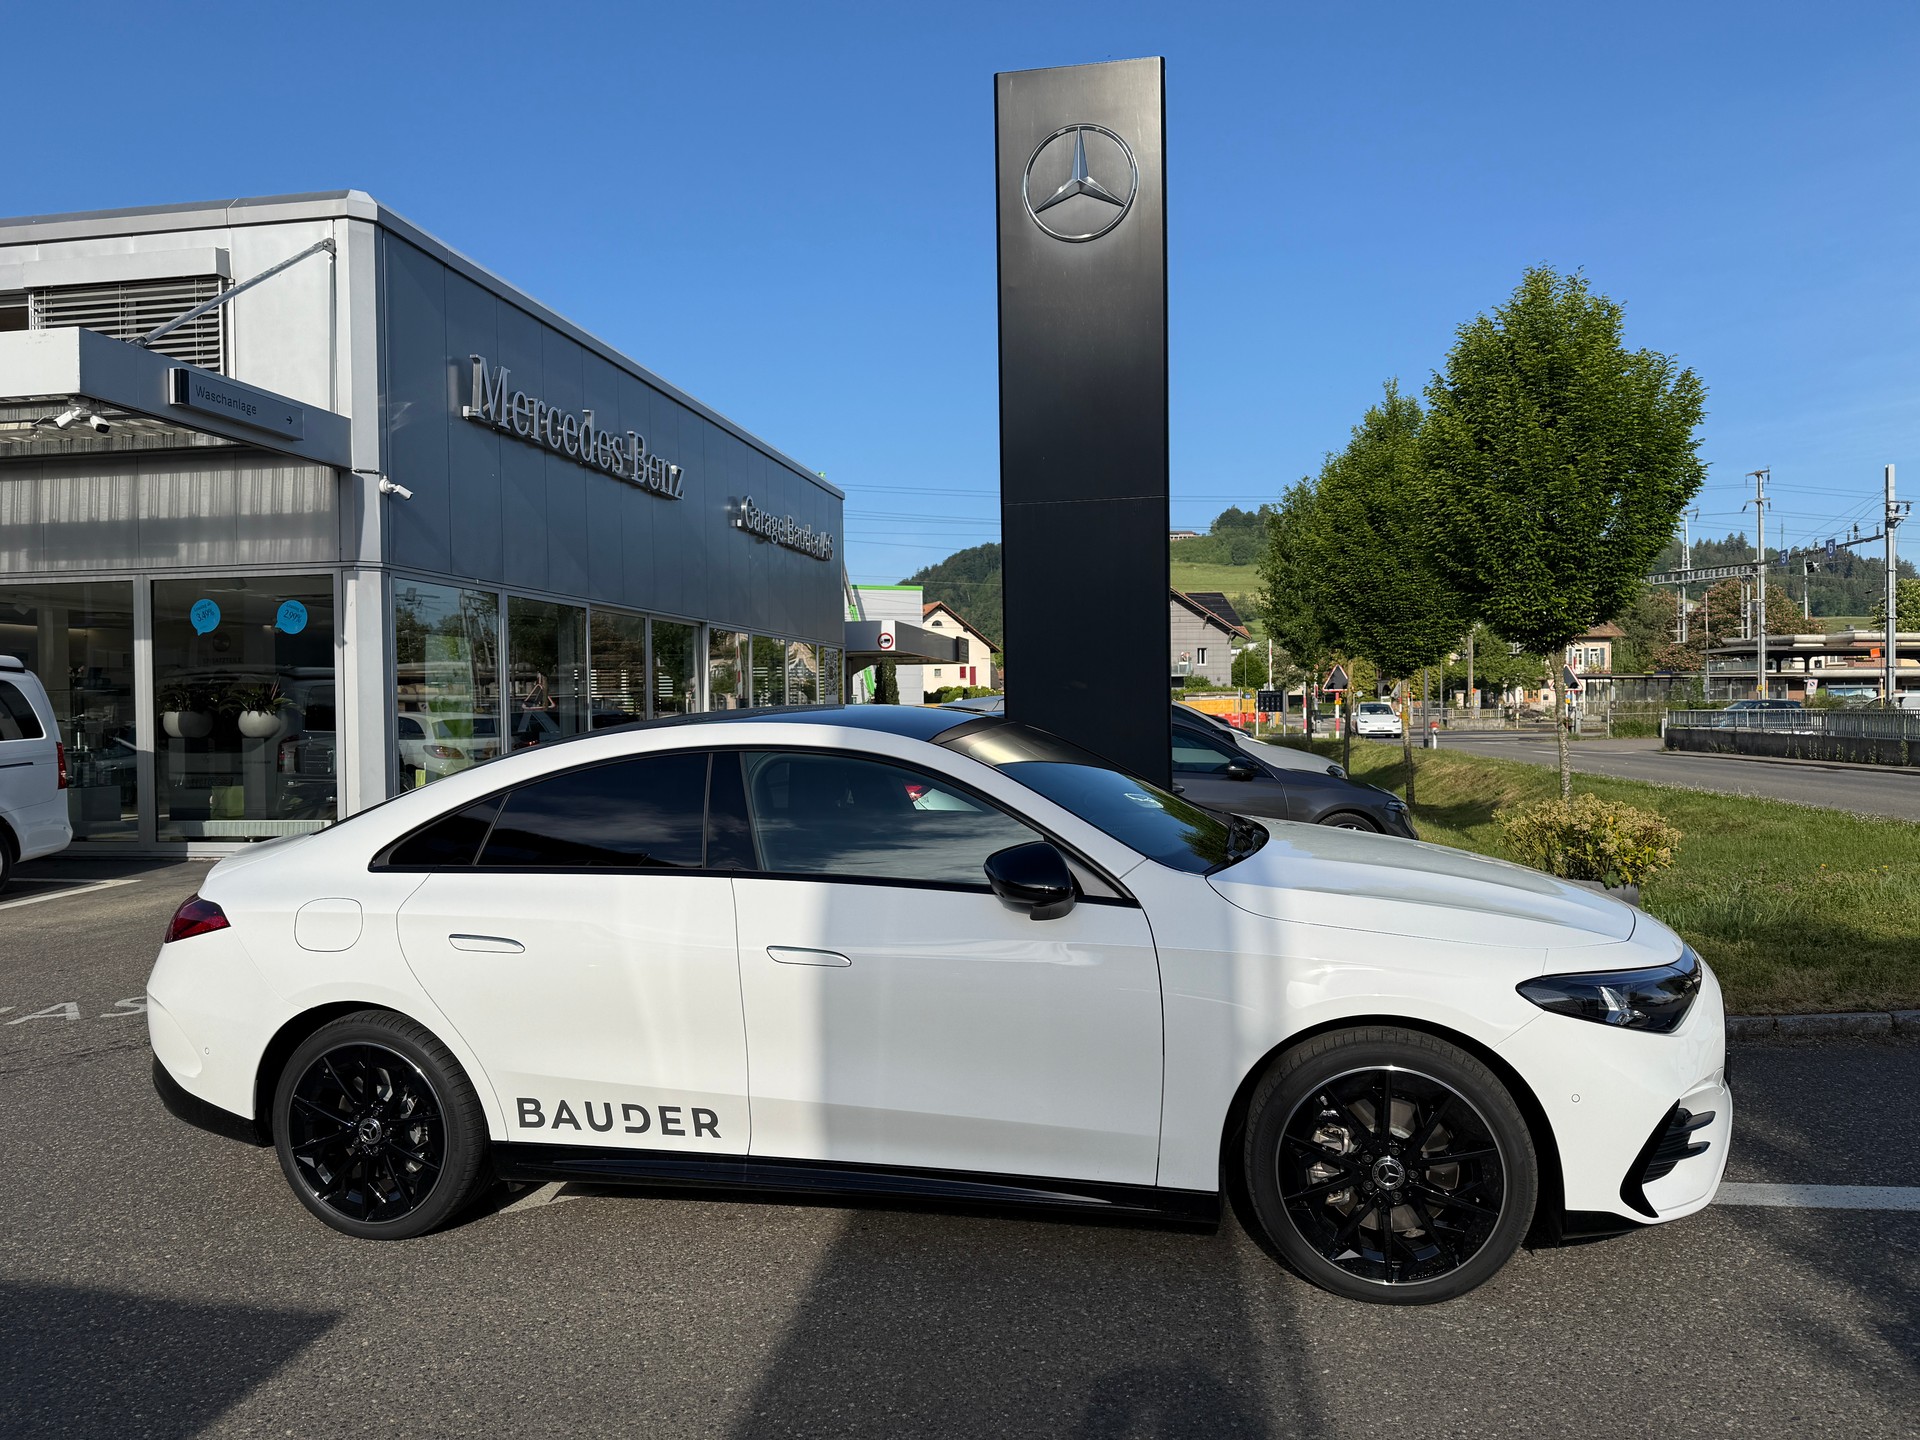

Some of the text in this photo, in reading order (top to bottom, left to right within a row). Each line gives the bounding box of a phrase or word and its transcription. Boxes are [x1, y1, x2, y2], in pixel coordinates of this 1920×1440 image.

[195, 384, 257, 416] Waschanlage
[470, 354, 685, 500] Mercedes-Benz
[744, 495, 785, 545] Garage
[786, 514, 820, 556] Bauder
[1781, 552, 1786, 564] 5
[1828, 541, 1833, 554] 6
[516, 1097, 722, 1139] BAUDER
